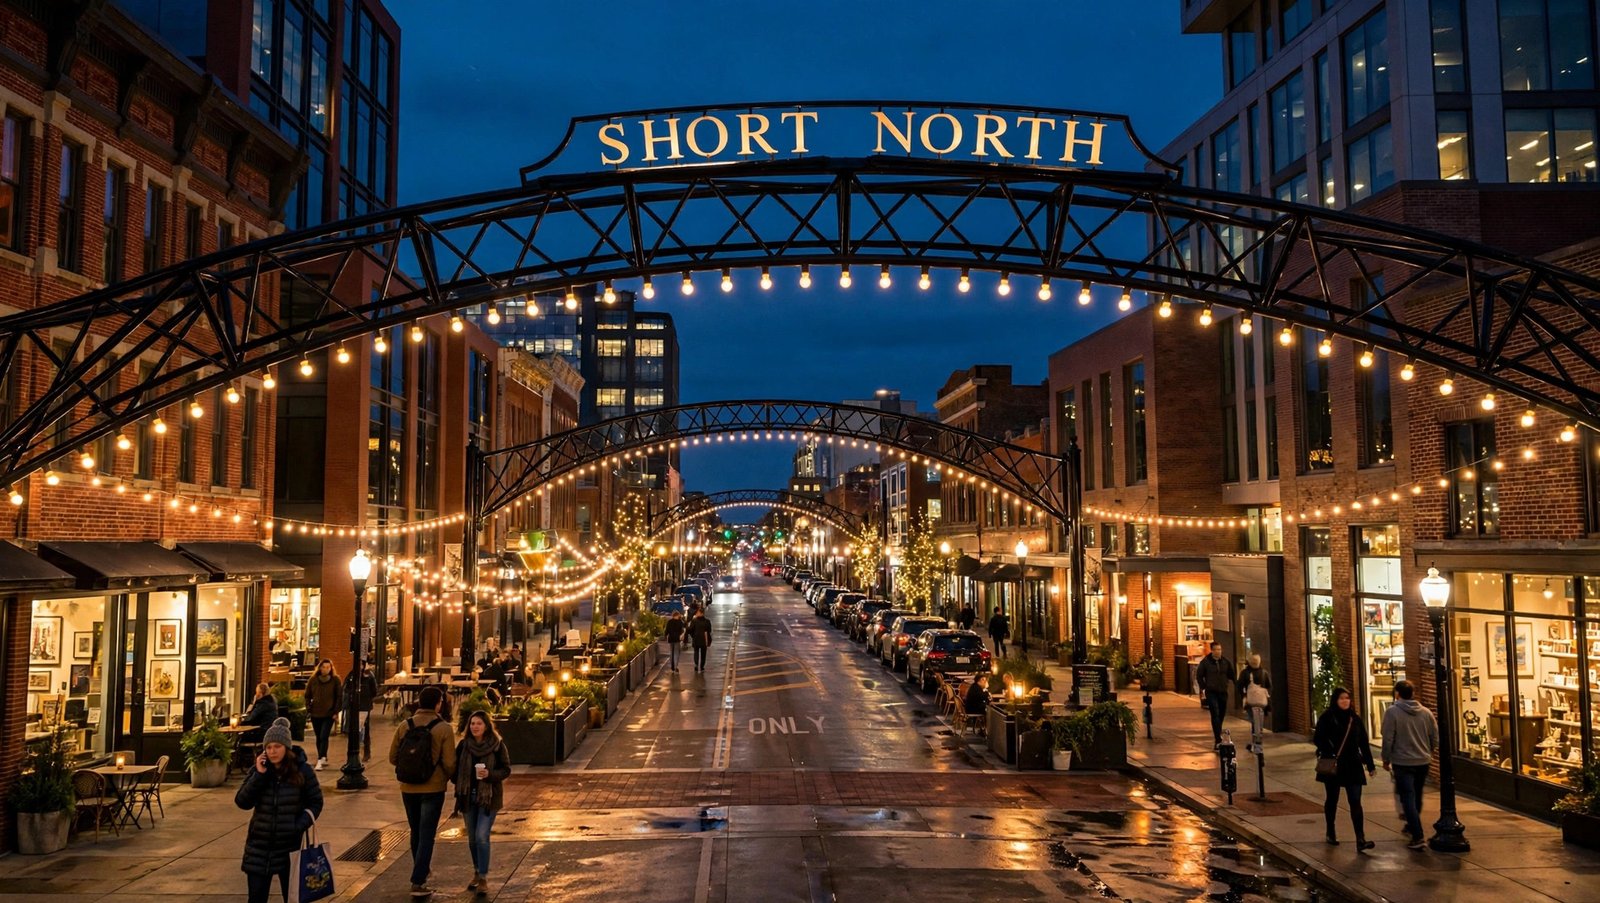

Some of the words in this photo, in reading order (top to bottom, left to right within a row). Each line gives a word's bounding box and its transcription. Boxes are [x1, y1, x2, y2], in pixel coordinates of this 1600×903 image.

[598, 111, 819, 166] SHORT
[870, 111, 1107, 166] NORTH
[748, 716, 825, 734] ONLY
